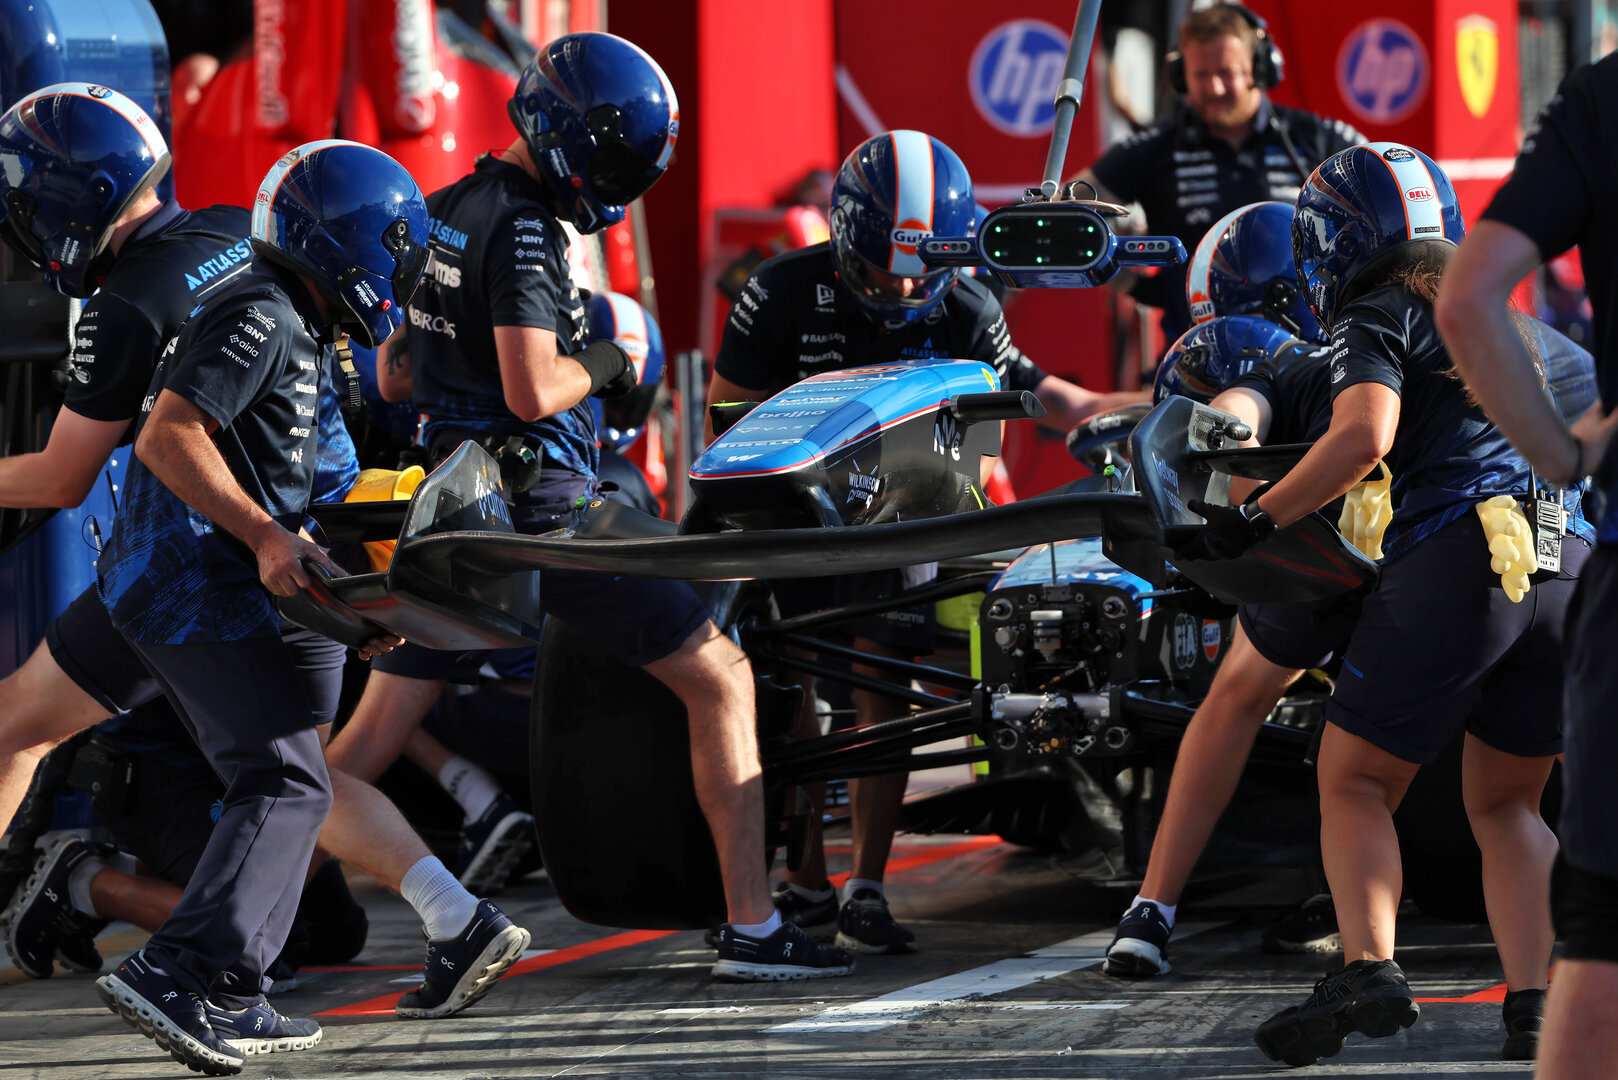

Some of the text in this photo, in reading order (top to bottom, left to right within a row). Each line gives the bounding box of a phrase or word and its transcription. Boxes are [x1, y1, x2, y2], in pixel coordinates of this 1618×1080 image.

[989, 23, 1066, 132] hp
[1352, 24, 1415, 120] hp
[1409, 190, 1431, 199] BELL
[521, 235, 544, 245] BNY
[893, 230, 931, 243] Gul
[1190, 302, 1213, 317] Gulf
[243, 323, 268, 343] BNY
[220, 346, 250, 369] nuveen
[238, 339, 259, 358] airia
[1175, 624, 1197, 657] FIA
[1202, 626, 1219, 643] Gulf
